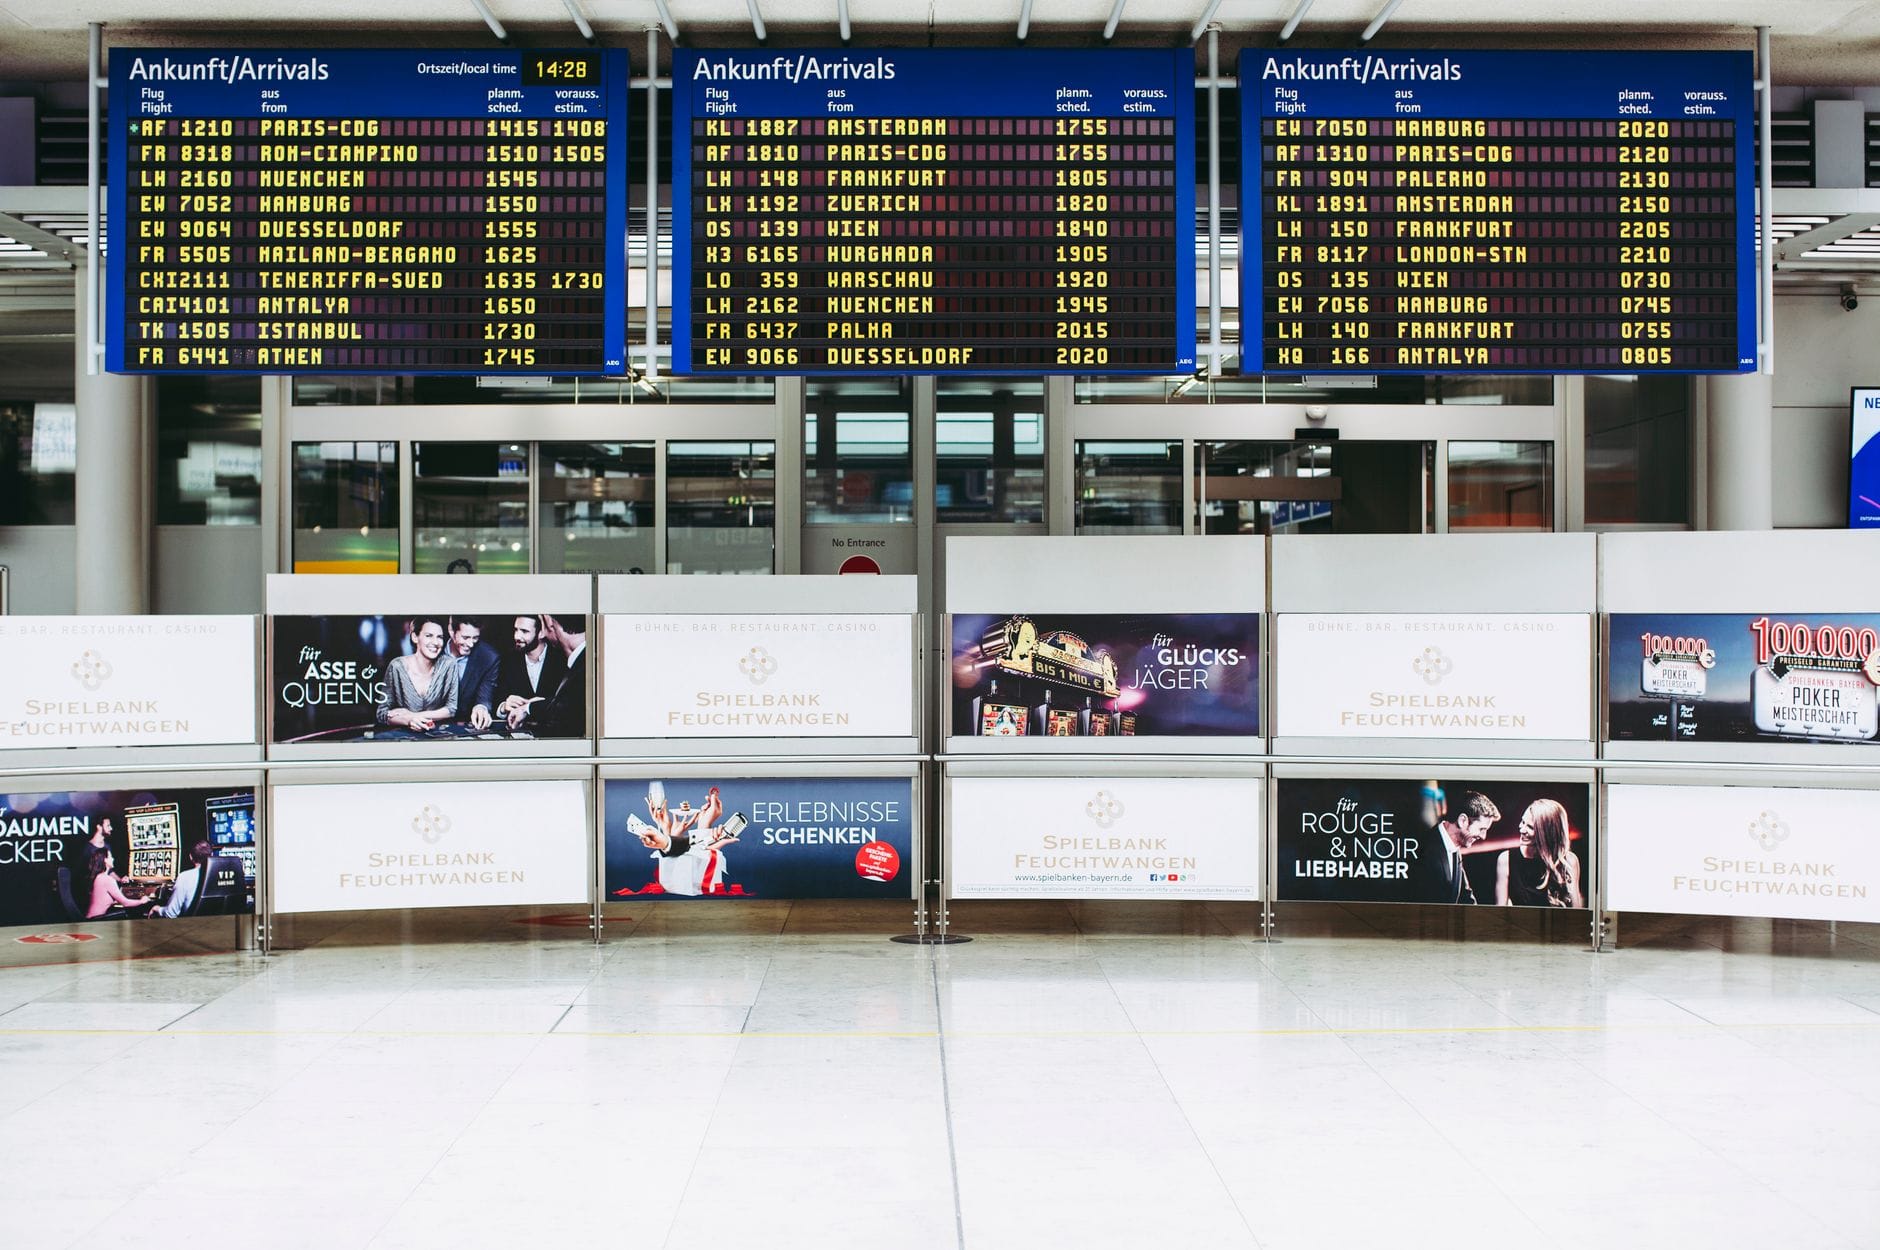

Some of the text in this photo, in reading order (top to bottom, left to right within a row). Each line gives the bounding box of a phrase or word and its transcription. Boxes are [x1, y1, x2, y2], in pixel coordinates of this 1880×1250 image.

[129, 56, 329, 83] Ankunft/Arrivals
[417, 62, 518, 76] Ortszeit/local time
[536, 60, 588, 79] 14:28
[693, 55, 896, 83] Ankunft/Arrivals
[1262, 55, 1462, 84] Ankunft/Arrivals
[141, 88, 600, 101] Flug aus planm. vorauss.
[706, 87, 1168, 101] Flug aus planm. vorauss.
[1275, 88, 1727, 101] Flug aus planm. vorauss.
[141, 102, 588, 115] Flight from sched. estim.
[706, 101, 1156, 115] Flight from sched. estim.
[1275, 102, 1716, 115] Flight from sched. estim.
[141, 119, 605, 137] AF 1210 PARIS-CDG 1415 1408
[706, 119, 1107, 136] KL 1887 AMSTERDAM 1755
[1276, 119, 1669, 138] EW 7050 HAMBURG 2020
[141, 145, 605, 162] FR 8318 ROM-CIAMPINO 1510 1505
[706, 169, 1107, 187] LH 148 FRANKFURT 1805
[1277, 170, 1669, 188] FR 904 PALERMO 2130
[747, 195, 798, 212] 1192
[827, 195, 919, 212] ZUERICH
[1056, 195, 1107, 212] 1820
[140, 246, 536, 264] FR 5505 MAILAND-BERGAMO 1625
[747, 246, 798, 263] 6165
[827, 245, 933, 263] HURGHADA
[1056, 245, 1107, 262] 1905
[1277, 246, 1670, 263] FR 8117 LONDON-STN 2210
[259, 271, 442, 289] TENERIFFA-SUED
[485, 272, 536, 289] 1635
[552, 272, 603, 289] 1730
[139, 296, 536, 314] CAI4101 ANTALYA 1650
[706, 296, 1108, 314] LH 2162 MUENCHEN 1945
[1332, 347, 1369, 364] 166
[1398, 347, 1488, 364] ANTALYA
[1621, 347, 1672, 364] 0805
[832, 538, 886, 547] No Entrance
[1152, 633, 1173, 649] für
[1752, 617, 1877, 663] 100.000
[299, 646, 321, 664] für
[1157, 645, 1246, 665] GLÜCKS-
[304, 662, 356, 679] ASSE
[1035, 661, 1056, 676] BIS
[1059, 669, 1065, 679] 1
[1093, 679, 1102, 688] €
[1128, 664, 1208, 689] JÄGER
[282, 682, 388, 707] QUEENS
[1792, 687, 1840, 708] POKER
[1773, 706, 1858, 725] MEISTERSCHAFT
[753, 802, 899, 823] ERLEBNISSE
[1337, 798, 1358, 813] für
[1302, 813, 1394, 834] ROUGE
[763, 827, 876, 844] SCHENKEN
[1330, 837, 1419, 859] & NOIR
[1015, 874, 1133, 883] www.spielbanken-bayern.de
[1296, 861, 1409, 879] LIEBHABER
